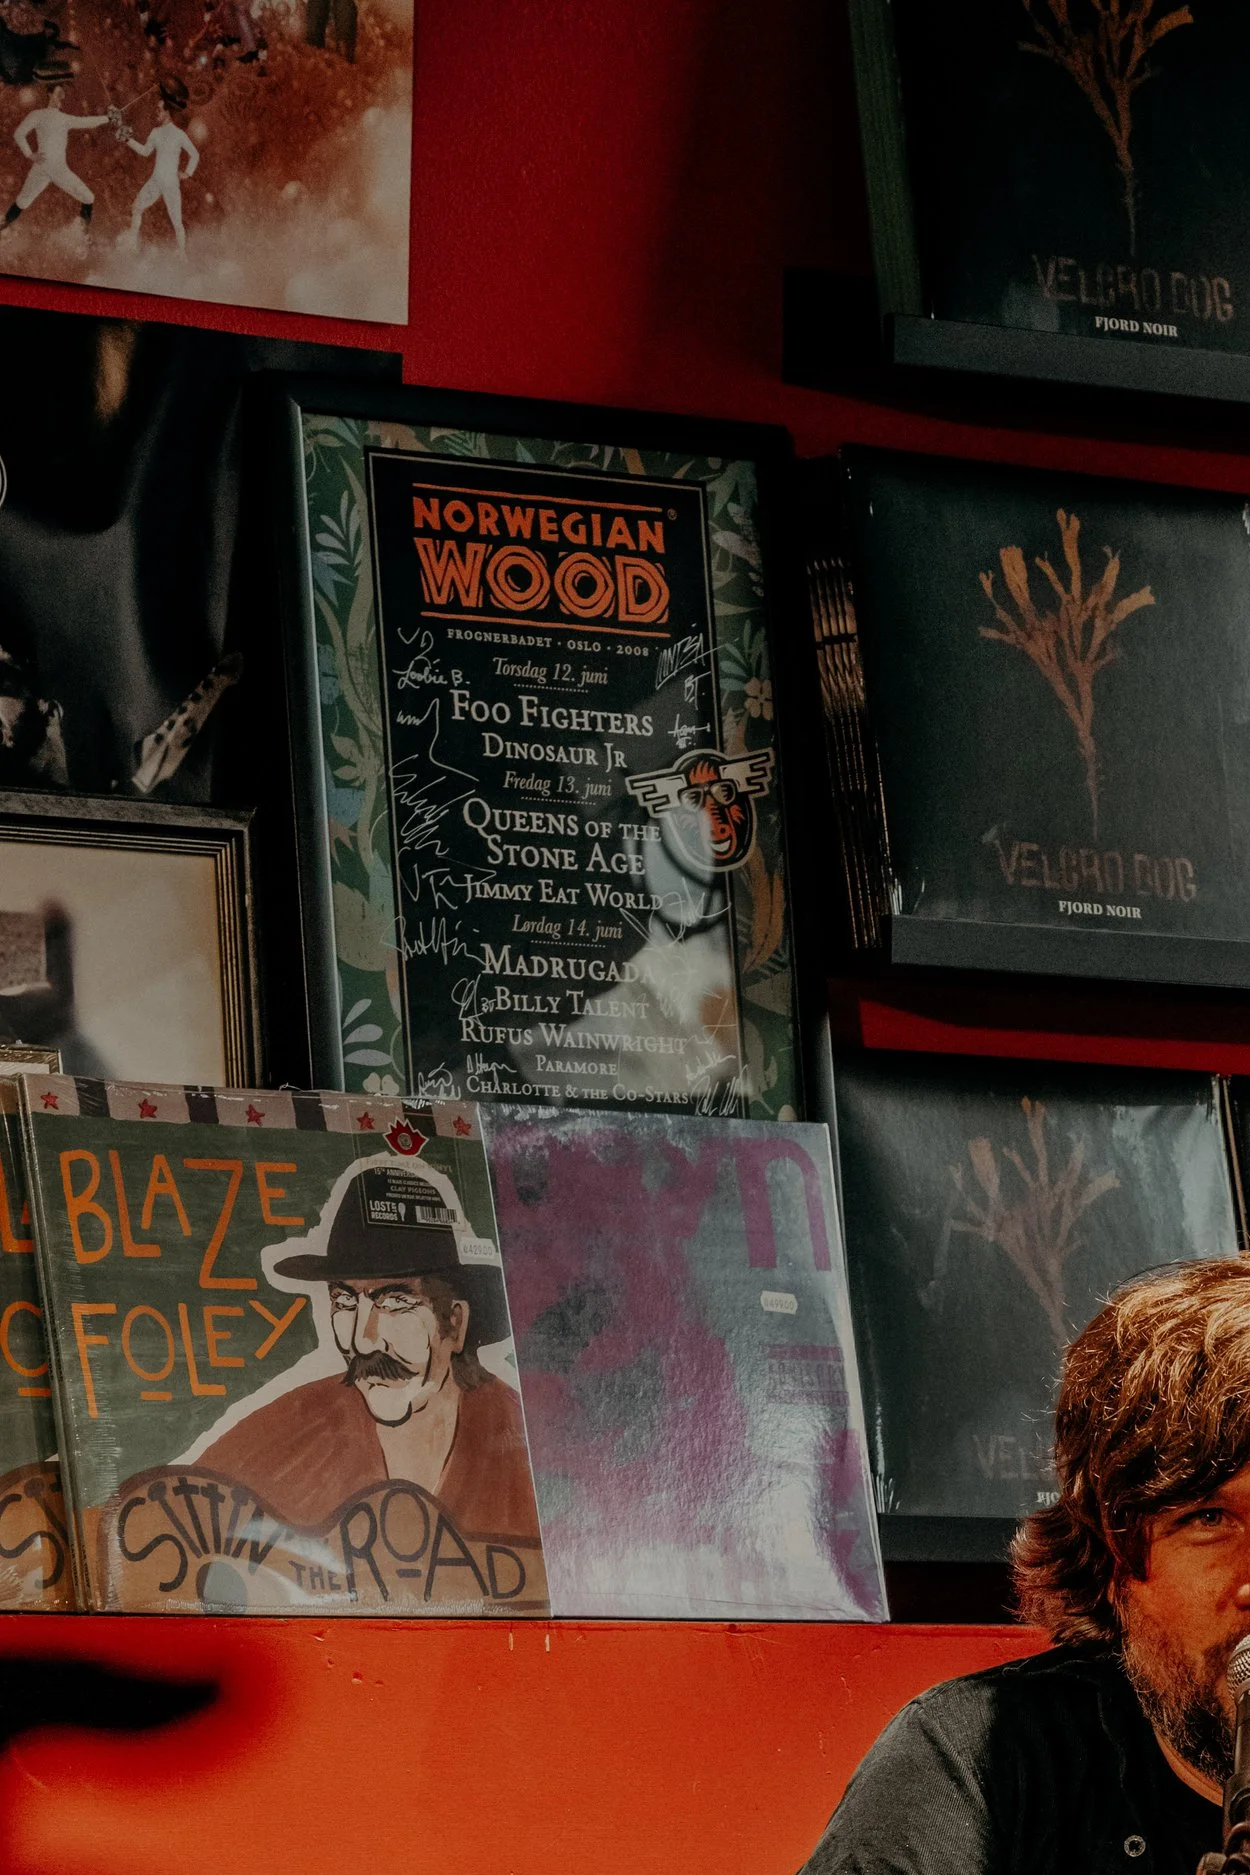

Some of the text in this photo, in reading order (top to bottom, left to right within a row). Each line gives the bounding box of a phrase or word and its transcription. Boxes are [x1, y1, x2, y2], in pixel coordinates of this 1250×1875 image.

[1095, 316, 1178, 337] FJORD NOIR
[413, 496, 665, 553] NORWEGIAN
[413, 537, 670, 624] WOOD
[447, 628, 649, 657] FROGNERBADET OSLO 2008
[493, 657, 608, 687] Torsdag 12. juni
[503, 771, 612, 797] Fredag 13. juni
[584, 821, 612, 838] OF
[619, 823, 661, 843] THE
[1058, 900, 1142, 919] FJORD NOIR
[512, 914, 623, 941] Lørdag 14. juni
[565, 1084, 579, 1098] &
[582, 1087, 608, 1100] THE
[59, 1149, 305, 1290] BLAZE
[369, 1200, 392, 1211] LOST
[71, 1297, 307, 1419] FOLEY
[288, 1560, 341, 1591] THE
[340, 1485, 525, 1602] ROAD
